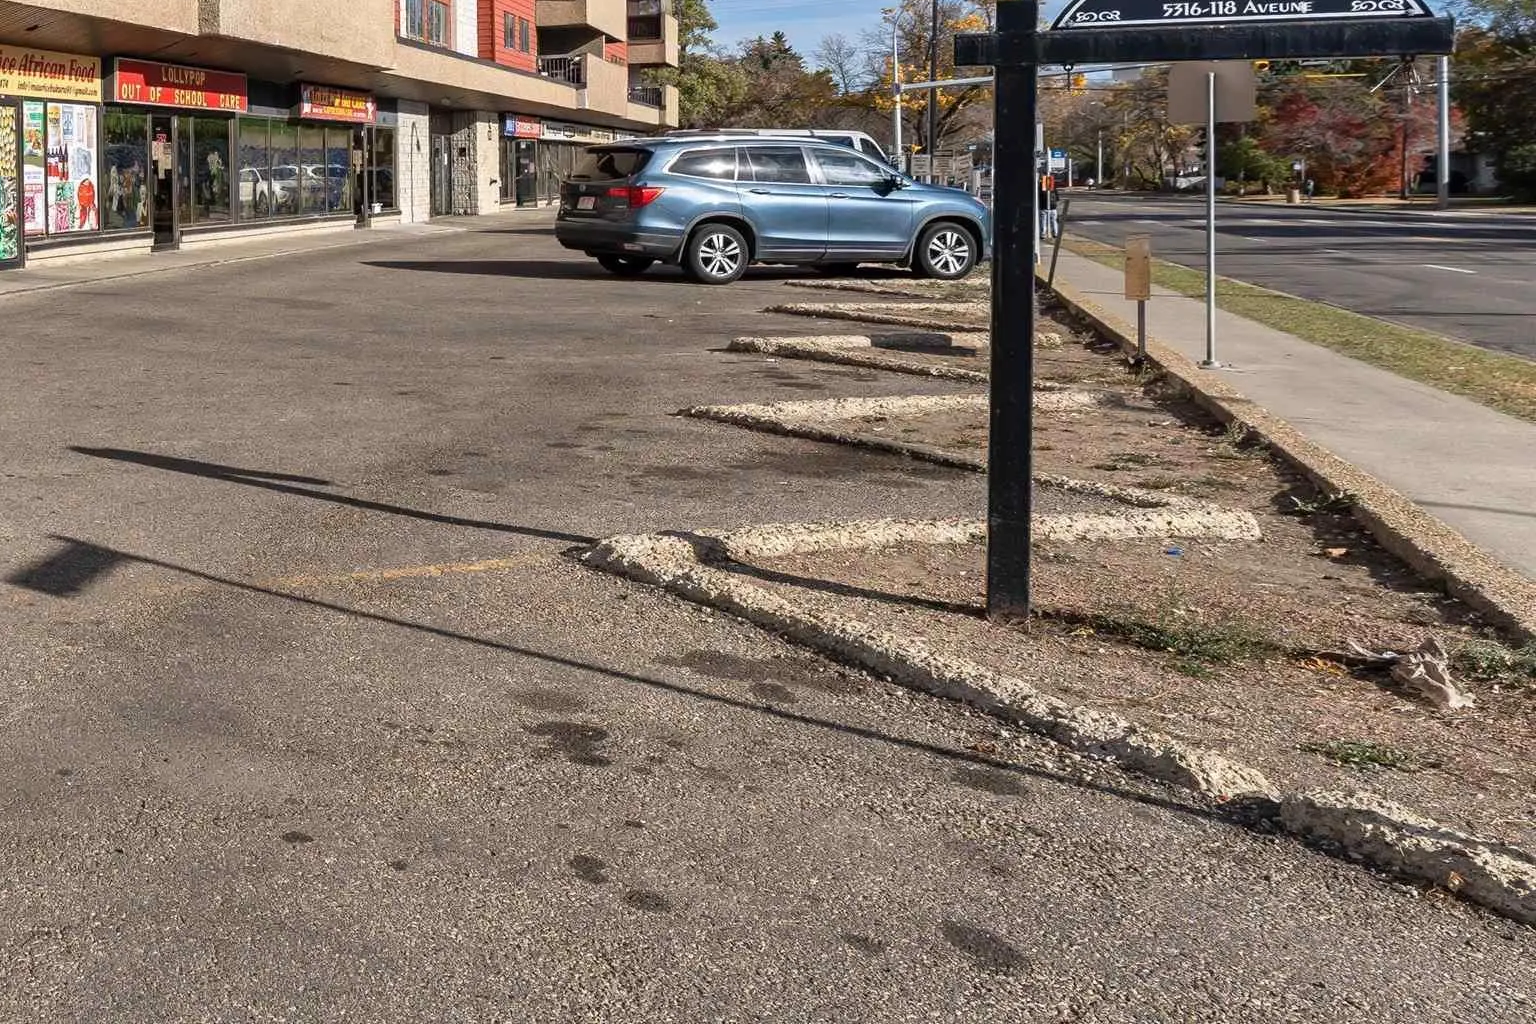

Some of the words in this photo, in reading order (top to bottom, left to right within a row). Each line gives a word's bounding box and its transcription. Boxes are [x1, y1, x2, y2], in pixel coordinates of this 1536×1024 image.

[1163, 0, 1237, 17] 5316-118
[18, 53, 67, 80] African
[68, 59, 96, 83] Food
[162, 66, 206, 86] LOLLYPOP
[121, 83, 141, 100] OUT
[150, 86, 162, 102] OF
[174, 89, 208, 107] SCHOOL
[220, 93, 241, 109] CARE
